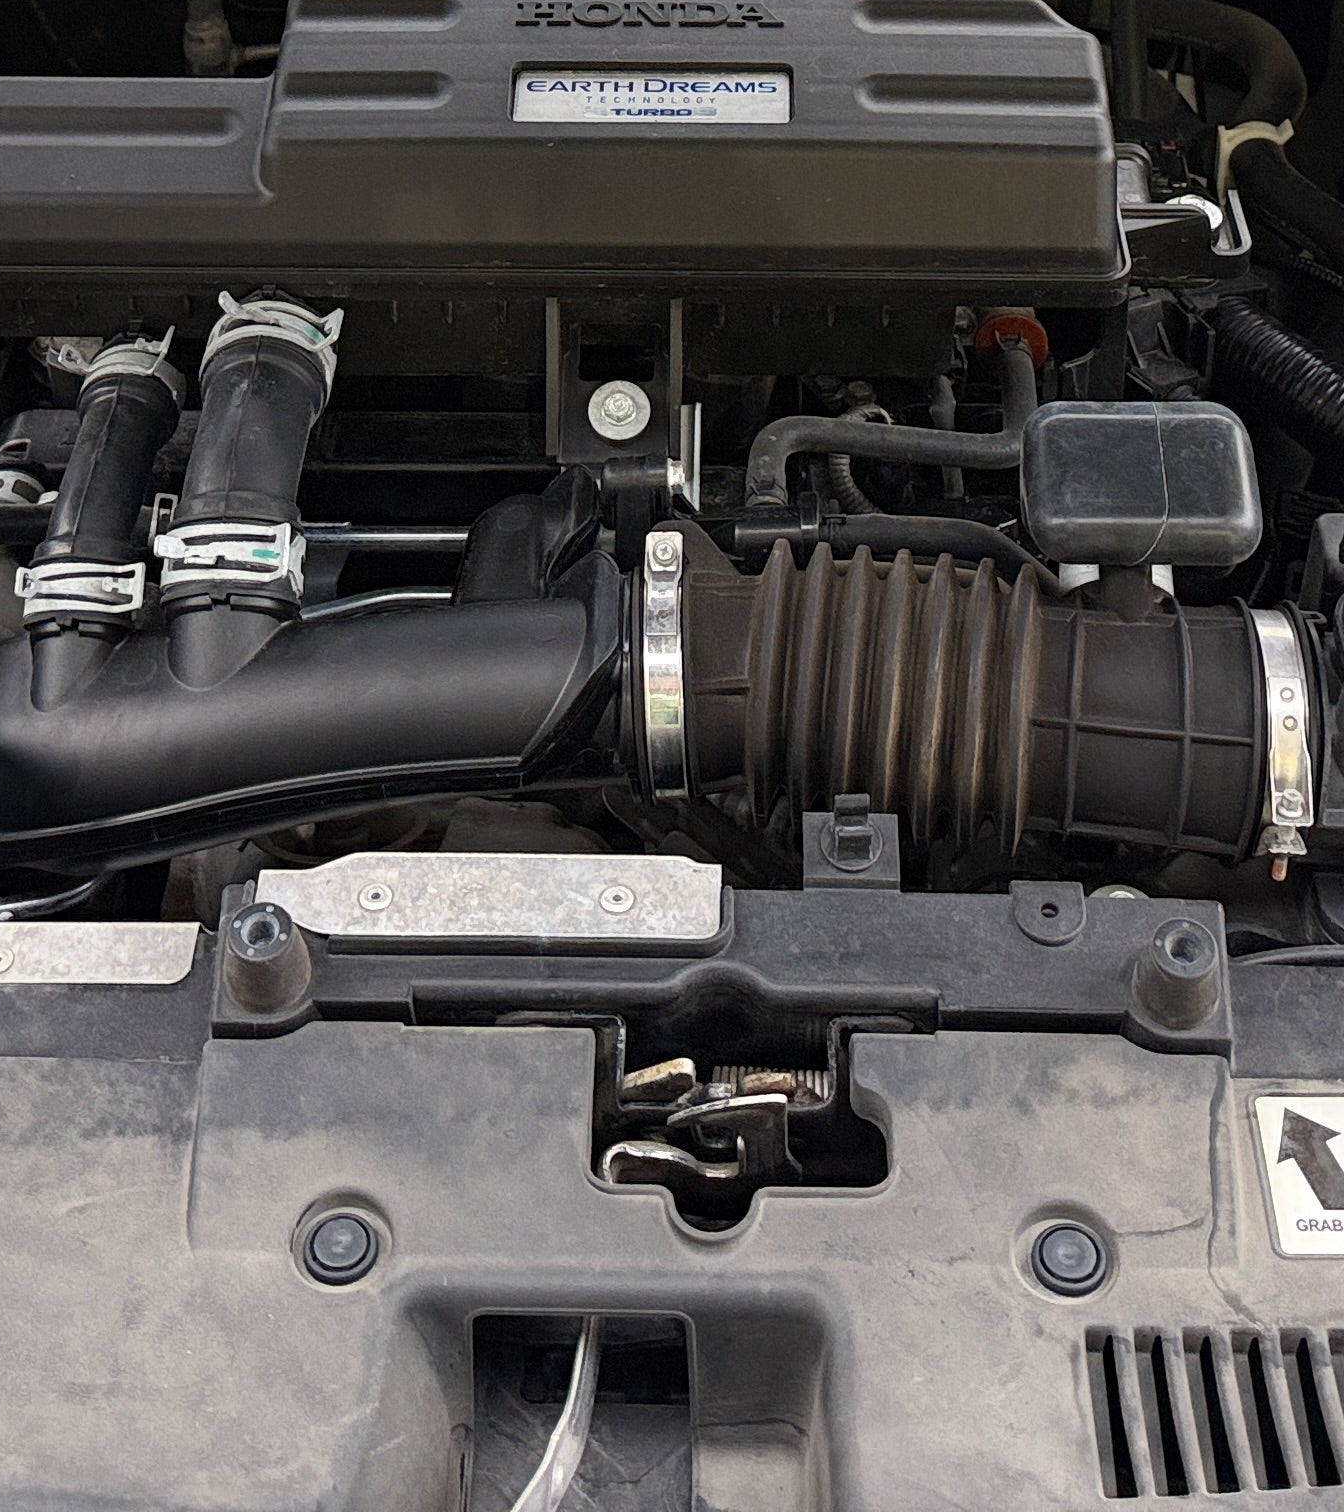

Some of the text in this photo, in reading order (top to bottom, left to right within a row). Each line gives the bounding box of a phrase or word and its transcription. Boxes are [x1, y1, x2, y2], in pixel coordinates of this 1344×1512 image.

[515, 1, 785, 29] HONDA
[526, 78, 778, 93] EARTH DREAMS
[586, 95, 717, 104] TECHNOLOGY
[610, 108, 693, 117] TURBO
[1296, 1218, 1344, 1233] GRAB
